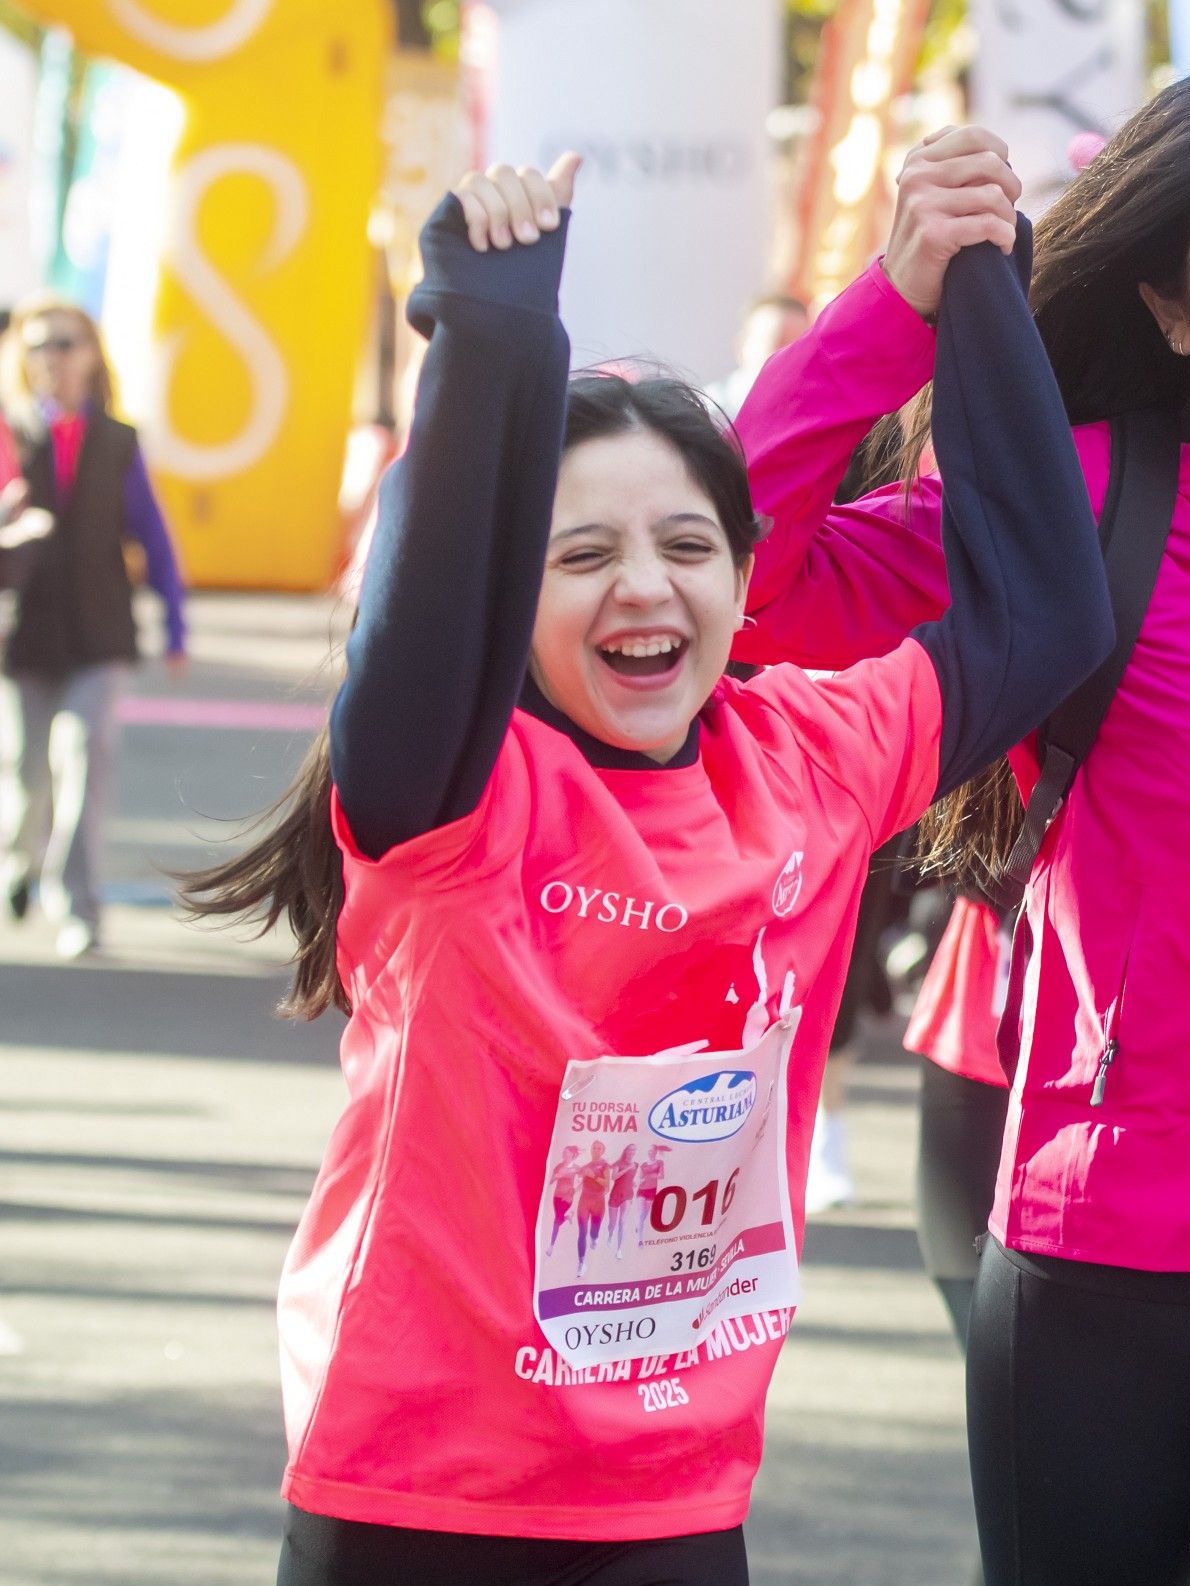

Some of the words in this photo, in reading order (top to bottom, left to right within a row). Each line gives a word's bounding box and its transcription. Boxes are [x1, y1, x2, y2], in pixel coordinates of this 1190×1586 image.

[540, 881, 688, 932] OYSHO
[572, 1102, 586, 1112] TU
[589, 1102, 639, 1113] DORSAL
[571, 1114, 637, 1133] SUMA
[670, 1244, 717, 1272] 3169
[574, 1288, 640, 1307] CARRERA
[644, 1284, 663, 1300] DE
[665, 1281, 682, 1297] LA
[564, 1317, 656, 1350] OYSHO
[637, 1377, 690, 1412] 2025
